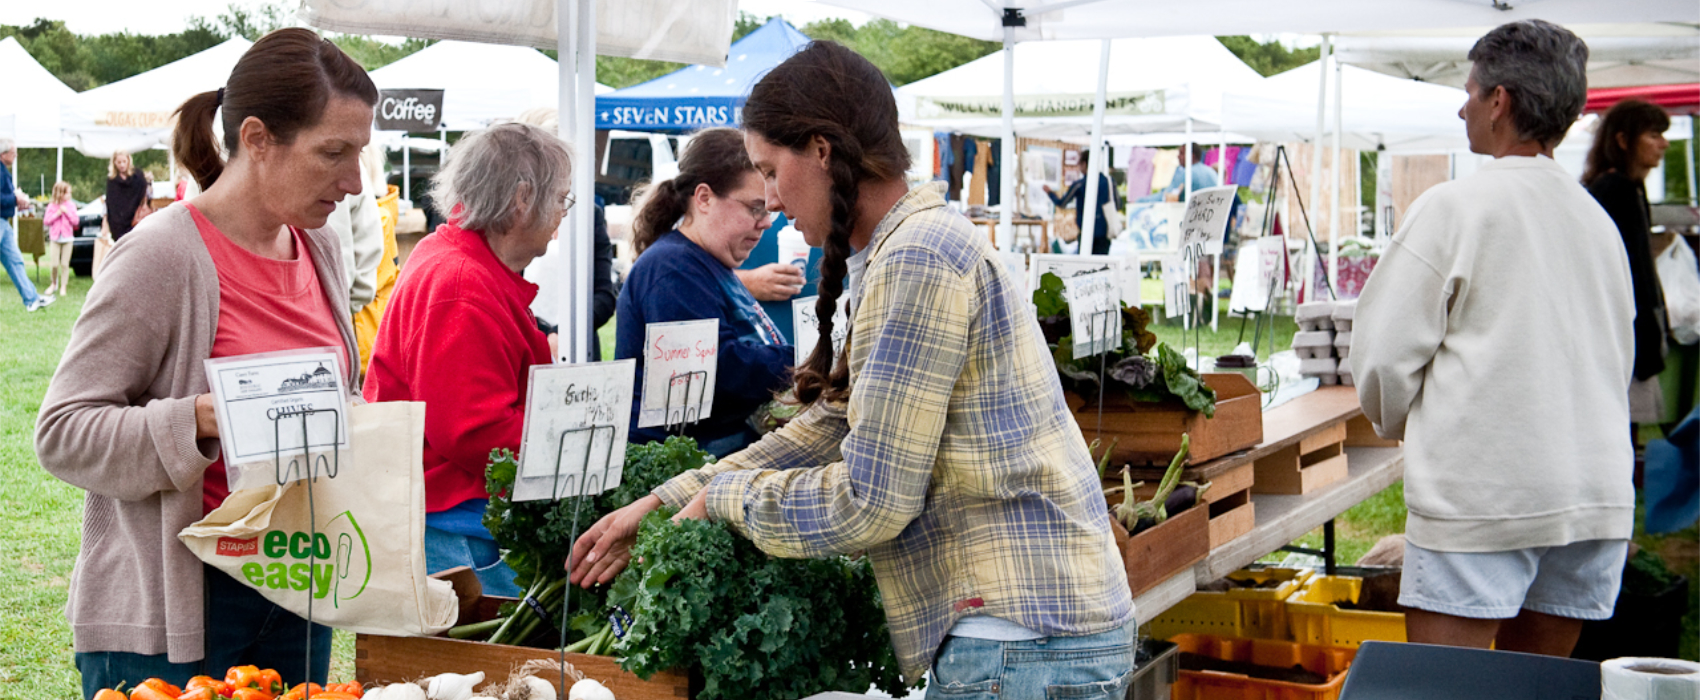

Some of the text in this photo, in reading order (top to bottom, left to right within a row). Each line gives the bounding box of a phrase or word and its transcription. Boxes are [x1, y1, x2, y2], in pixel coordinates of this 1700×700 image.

[381, 97, 436, 120] Coffee
[613, 107, 669, 124] SEVEN
[674, 106, 728, 125] STARS
[940, 101, 1027, 113] WILLYWW
[266, 403, 315, 421] CHIVES
[263, 530, 331, 560] eco
[241, 562, 334, 599] easy
